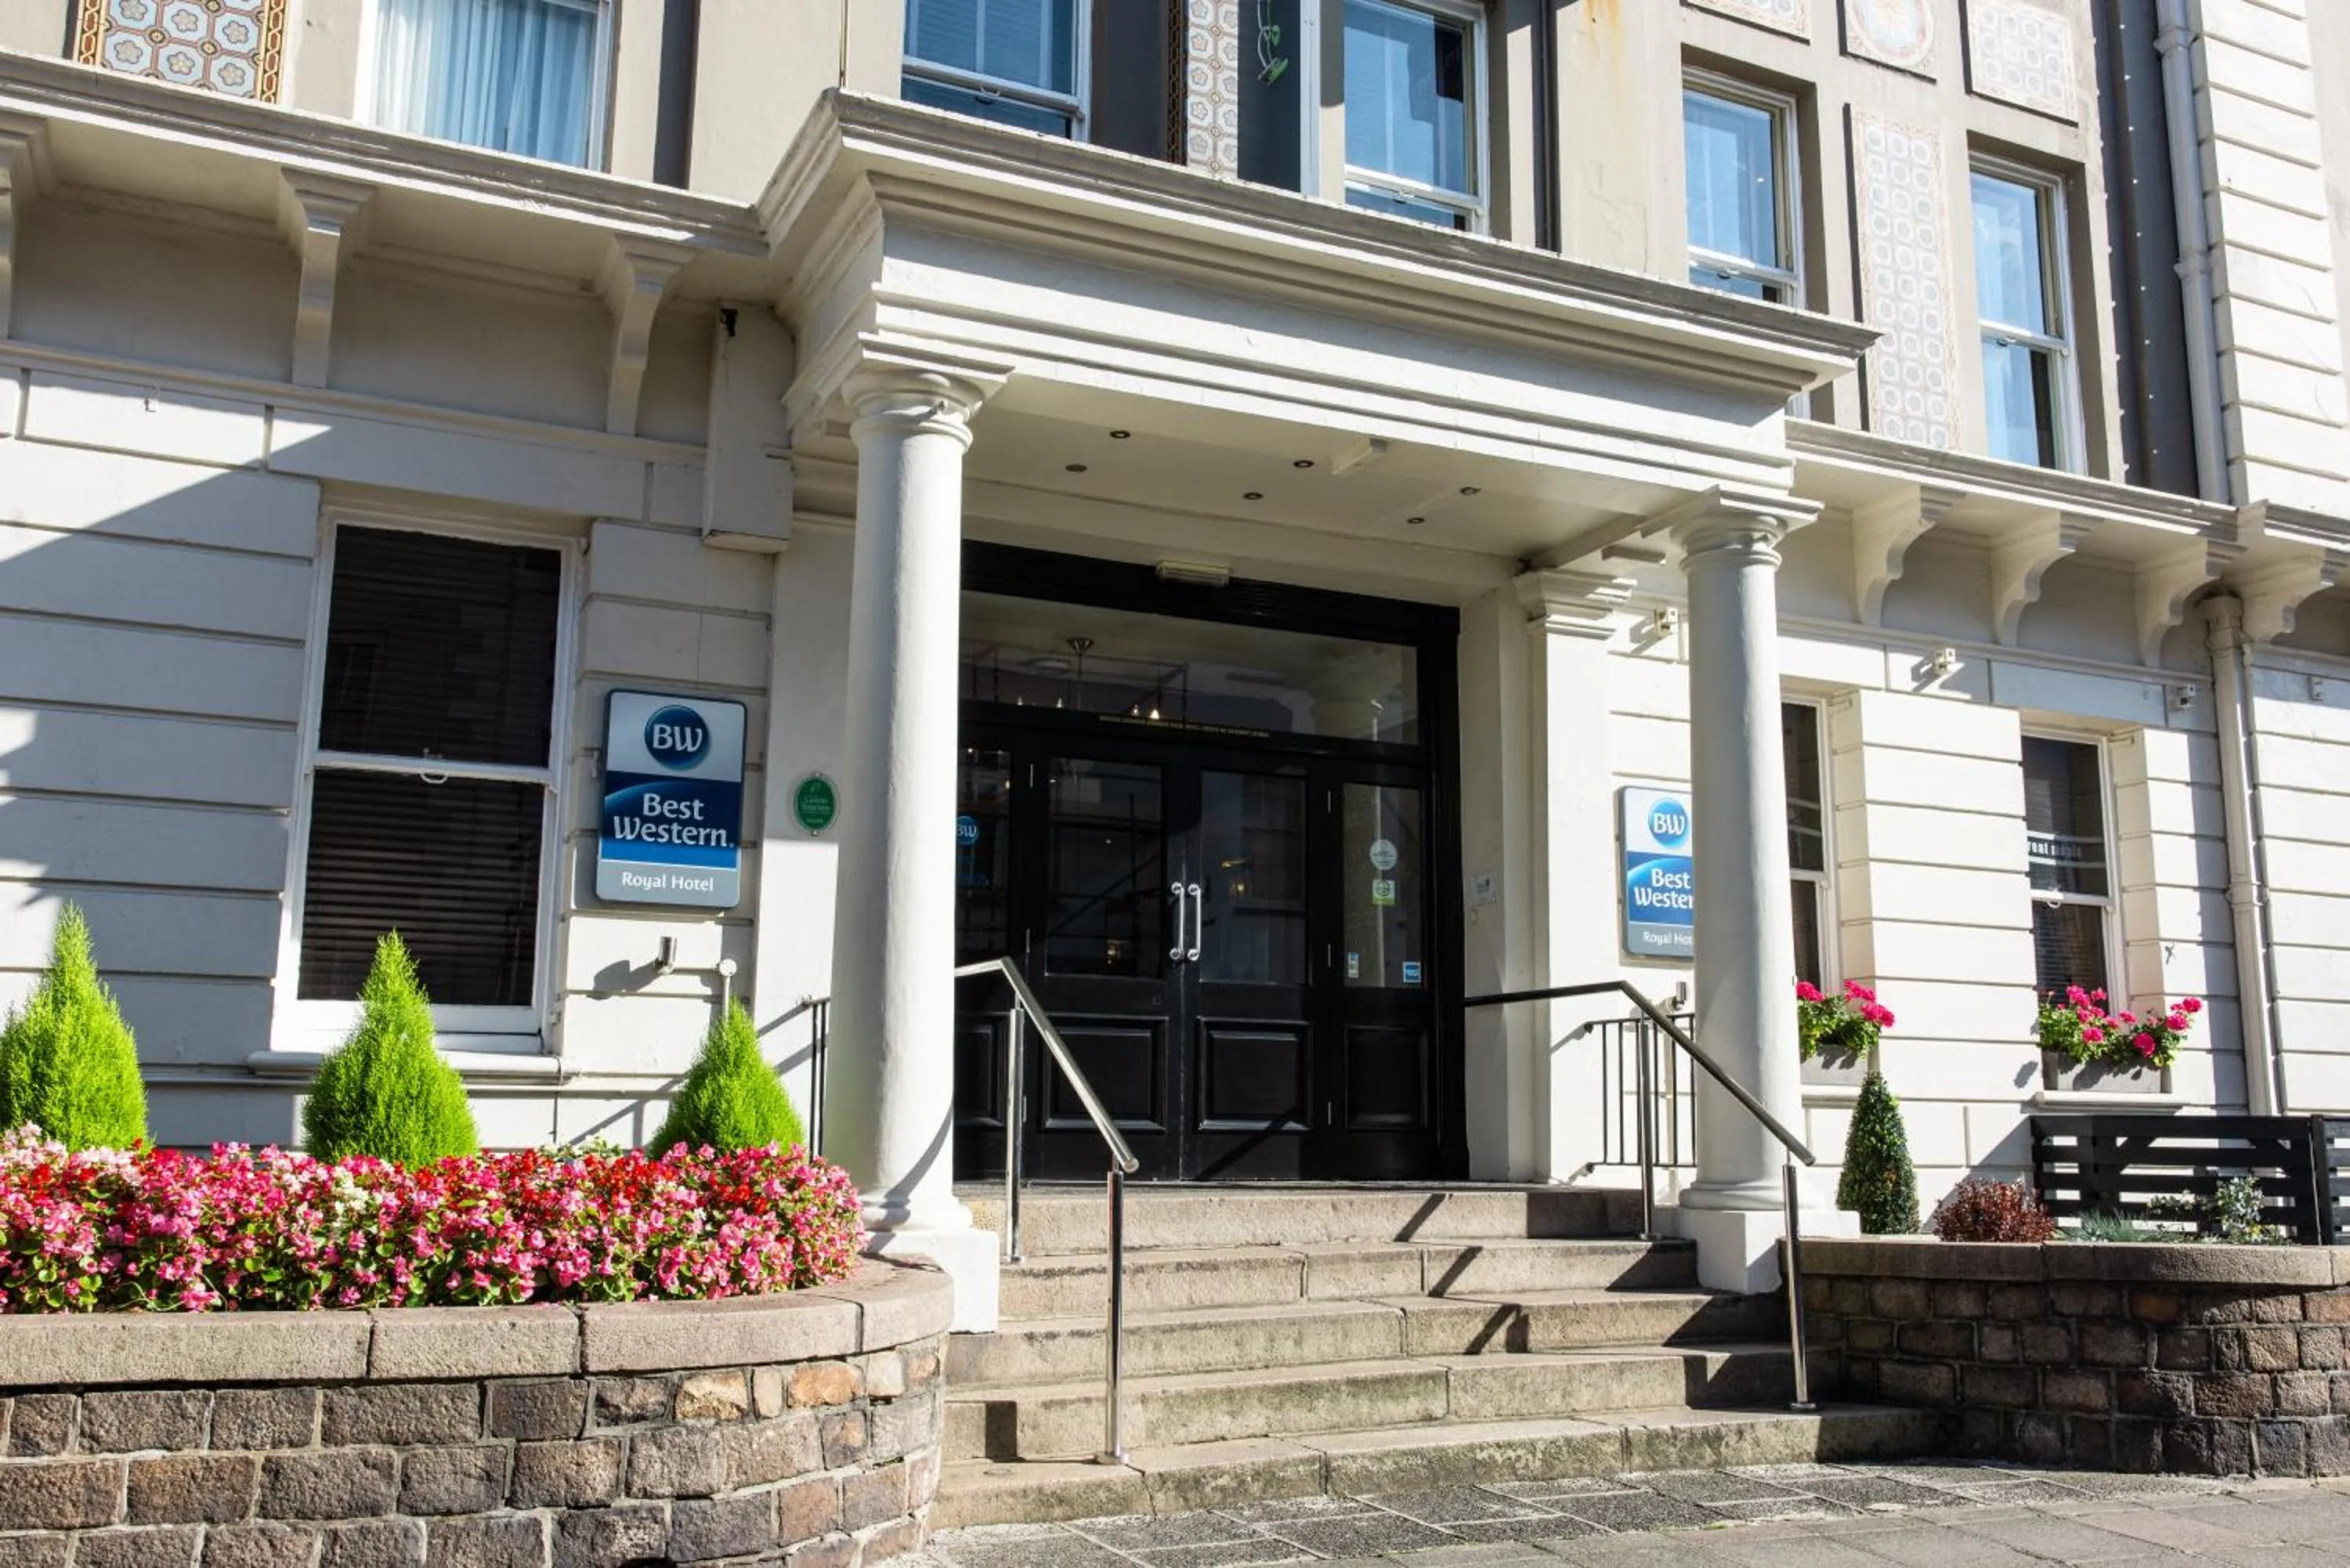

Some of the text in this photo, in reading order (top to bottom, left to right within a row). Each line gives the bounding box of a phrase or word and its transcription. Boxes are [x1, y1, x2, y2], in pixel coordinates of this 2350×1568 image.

[652, 724, 703, 752] BW
[642, 793, 704, 820] Best
[1654, 812, 1685, 835] BW
[621, 871, 714, 891] Royal Hotel
[1651, 869, 1691, 890] Best
[1634, 887, 1693, 909] Wester
[1643, 931, 1672, 946] Royal
